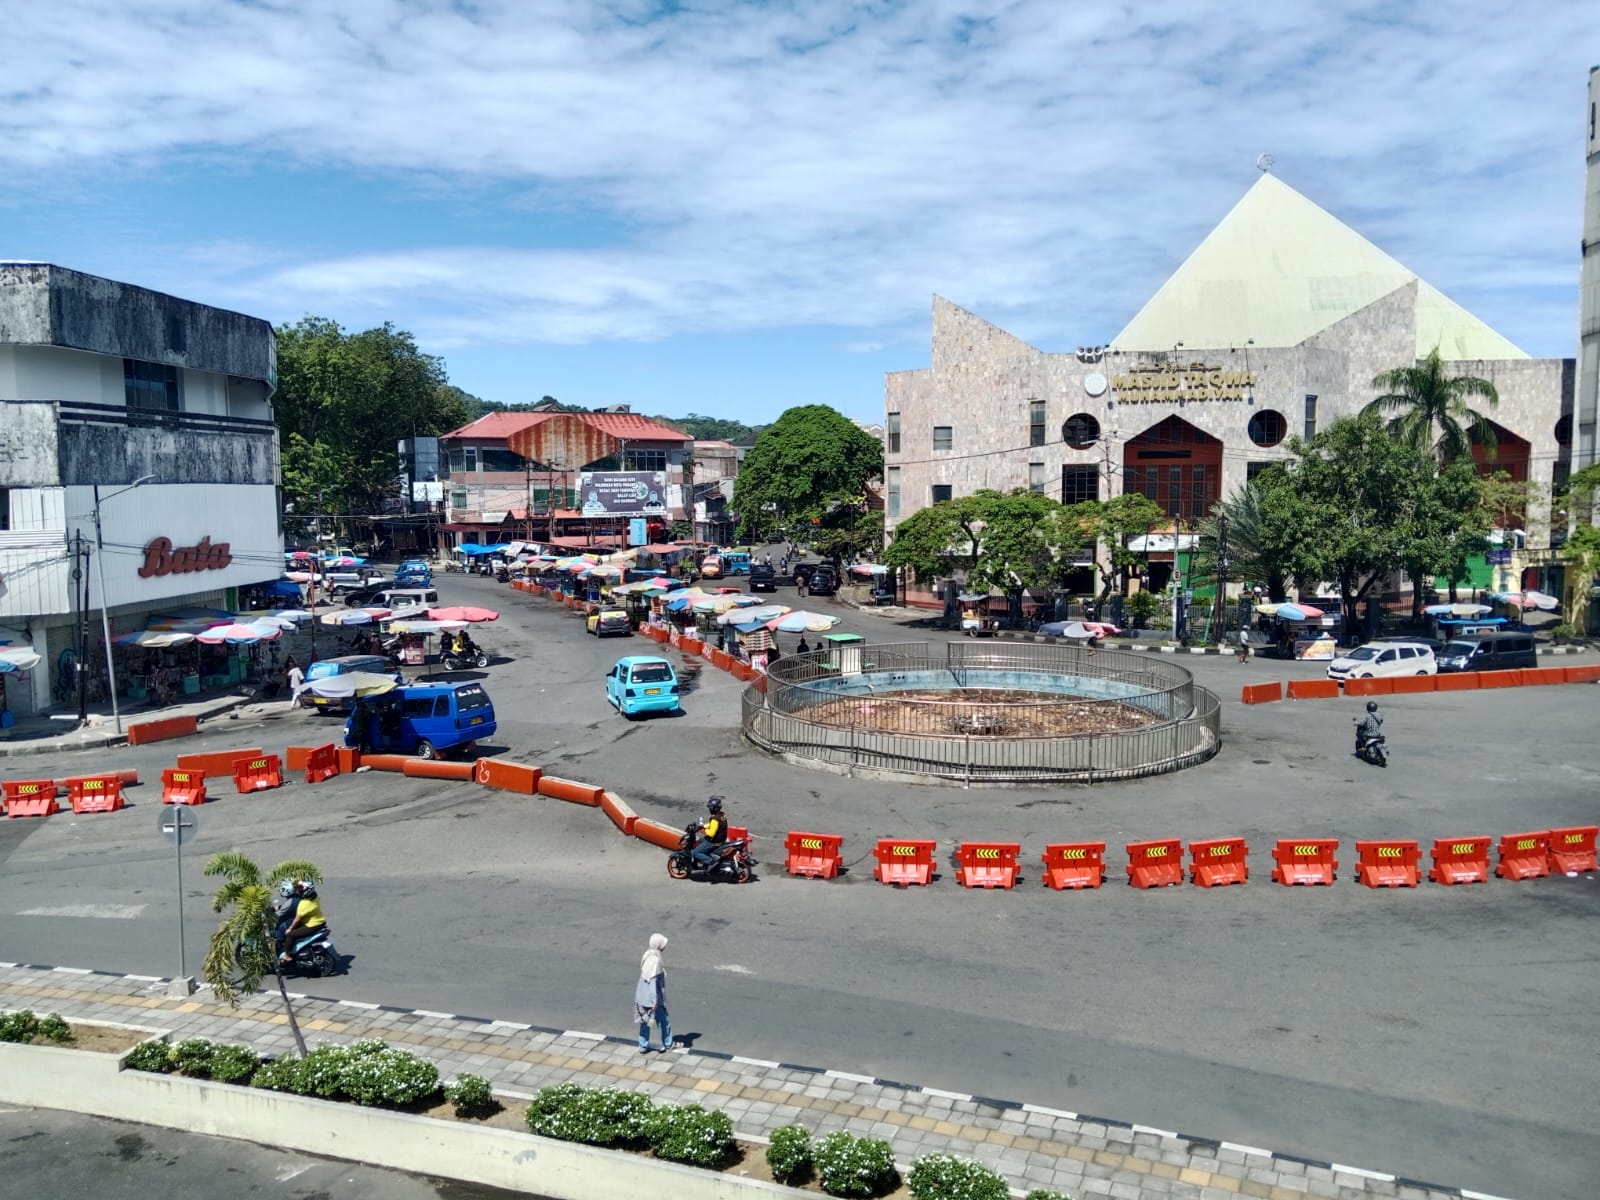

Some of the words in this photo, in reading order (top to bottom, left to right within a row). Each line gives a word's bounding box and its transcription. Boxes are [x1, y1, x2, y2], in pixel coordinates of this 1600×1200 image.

[1112, 372, 1181, 391] MASJID
[1184, 371, 1255, 390] TAQWA
[138, 535, 232, 578] Bata
